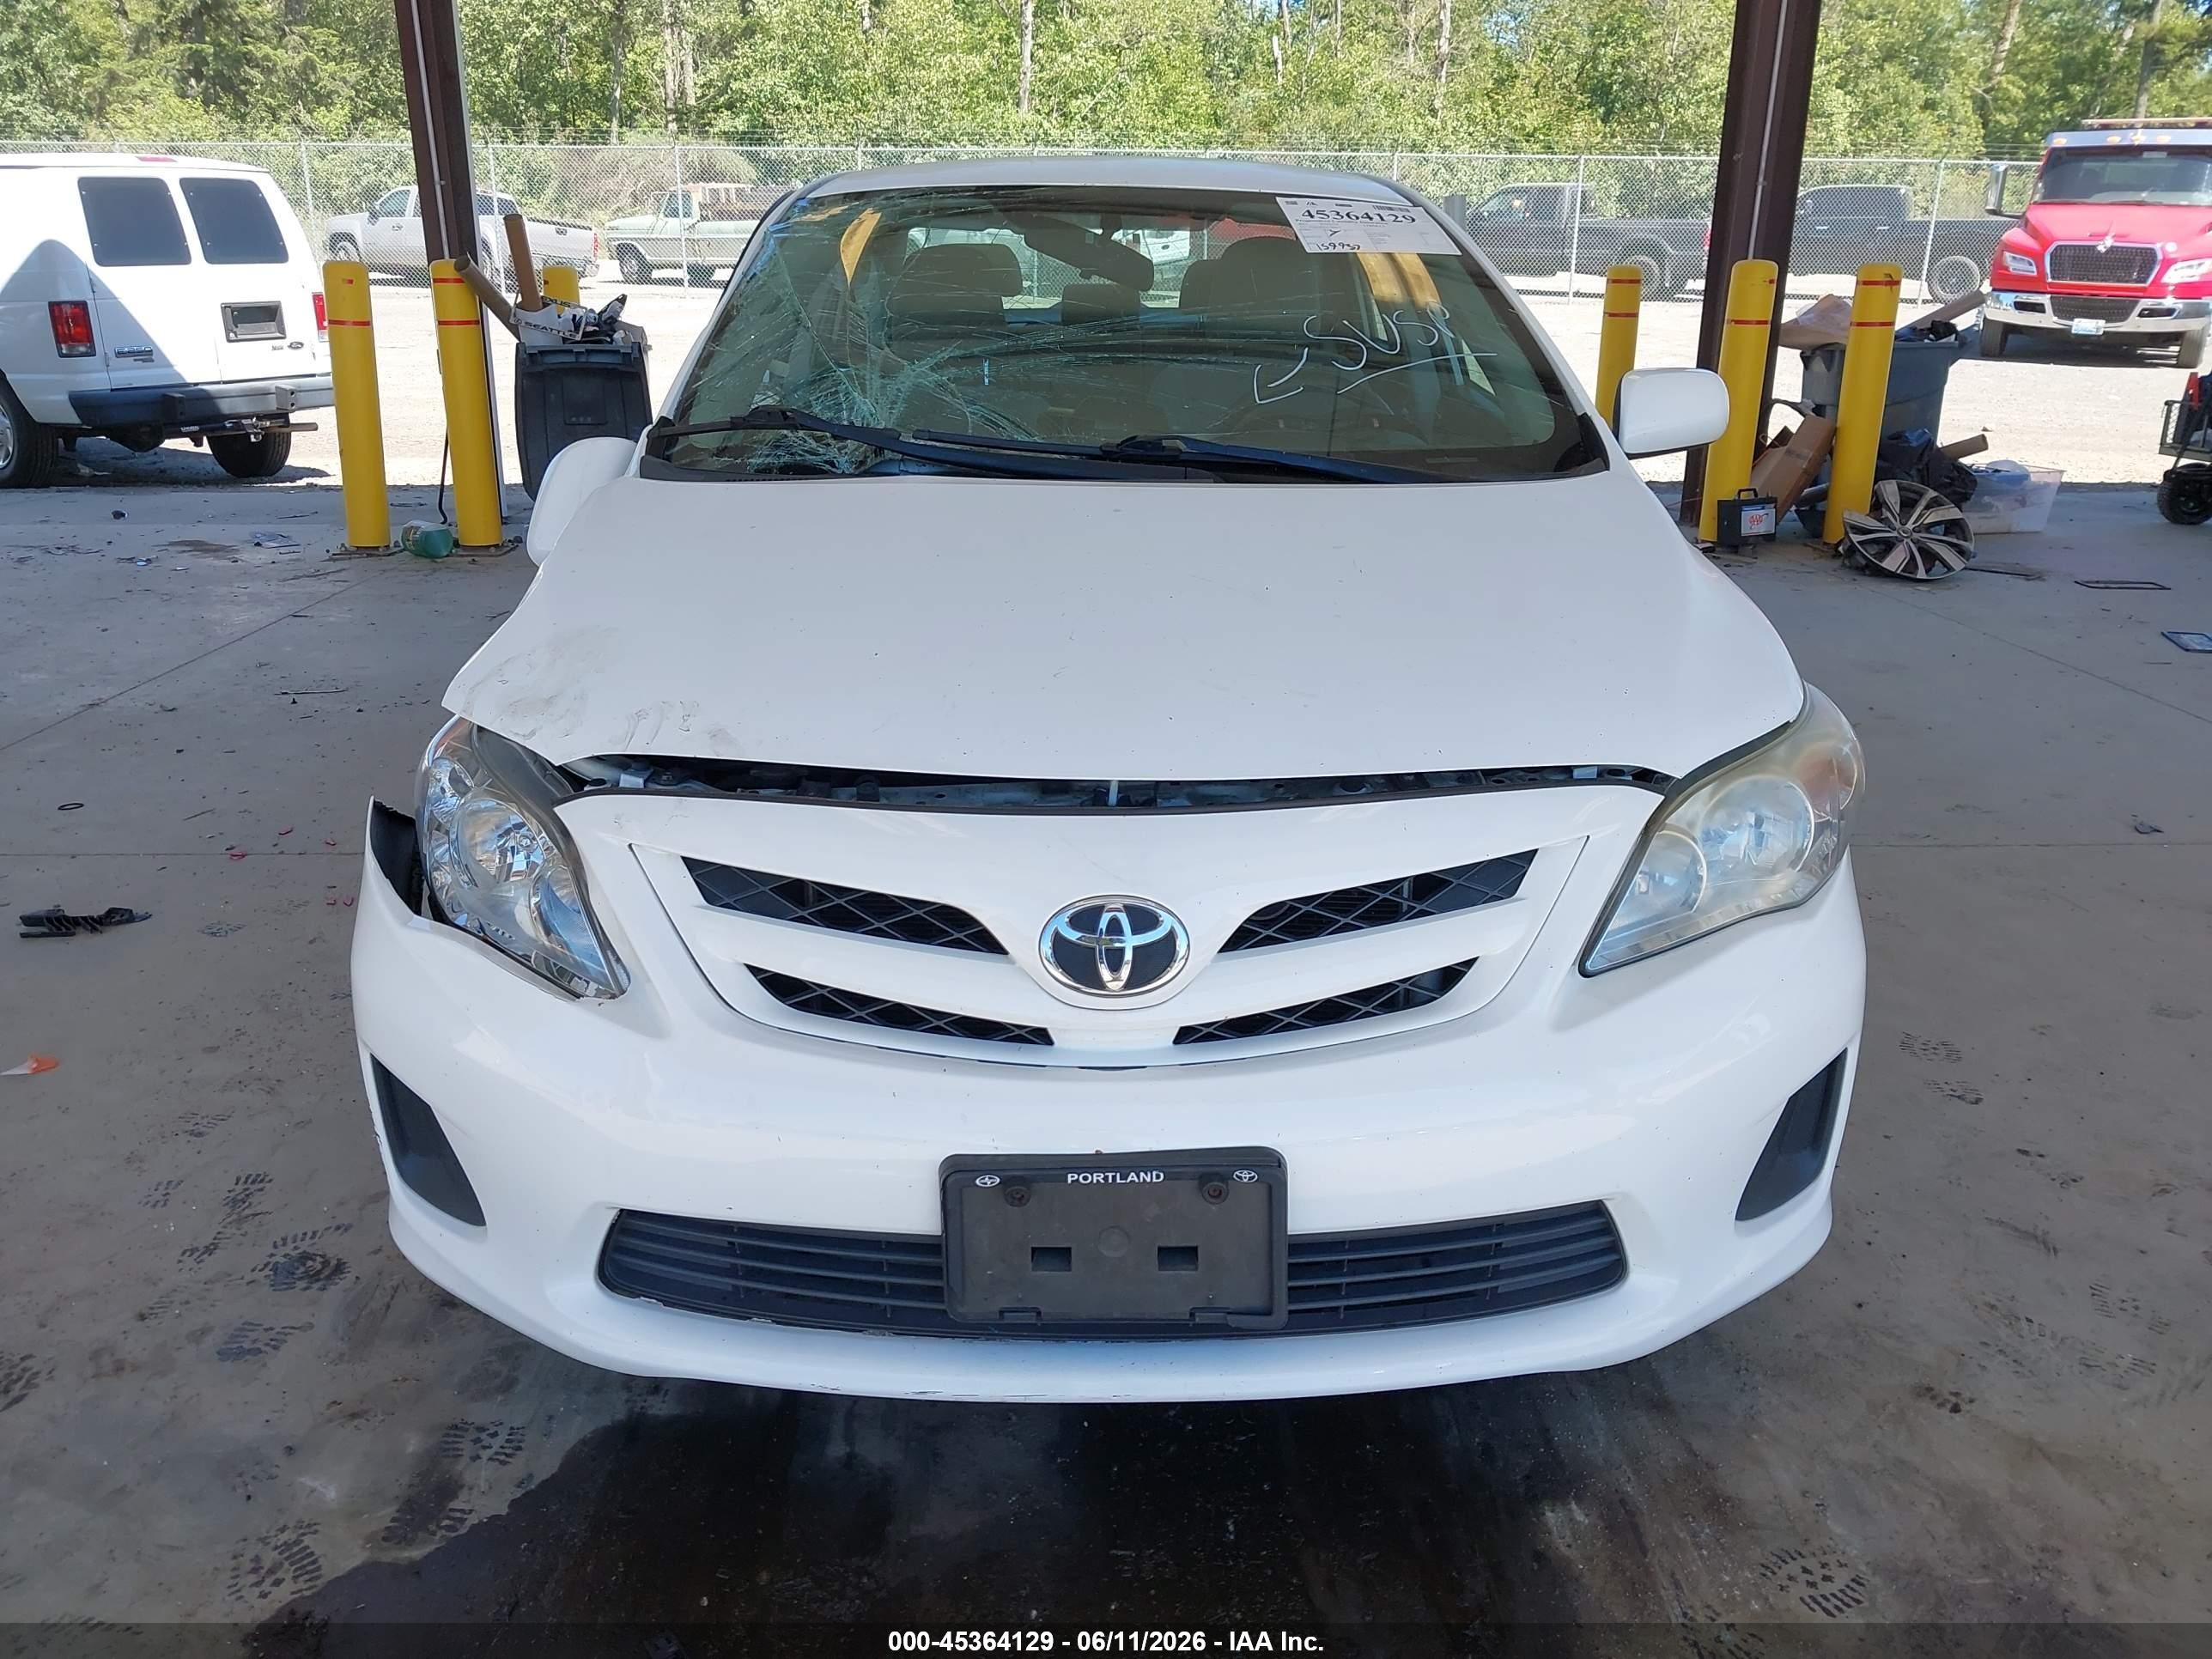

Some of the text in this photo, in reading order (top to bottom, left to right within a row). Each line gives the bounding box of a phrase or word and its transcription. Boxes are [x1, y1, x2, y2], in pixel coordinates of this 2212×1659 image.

[1301, 209, 1417, 224] 45364129
[524, 320, 577, 339] SEATTLE
[1066, 1170, 1164, 1184] PORTLAND
